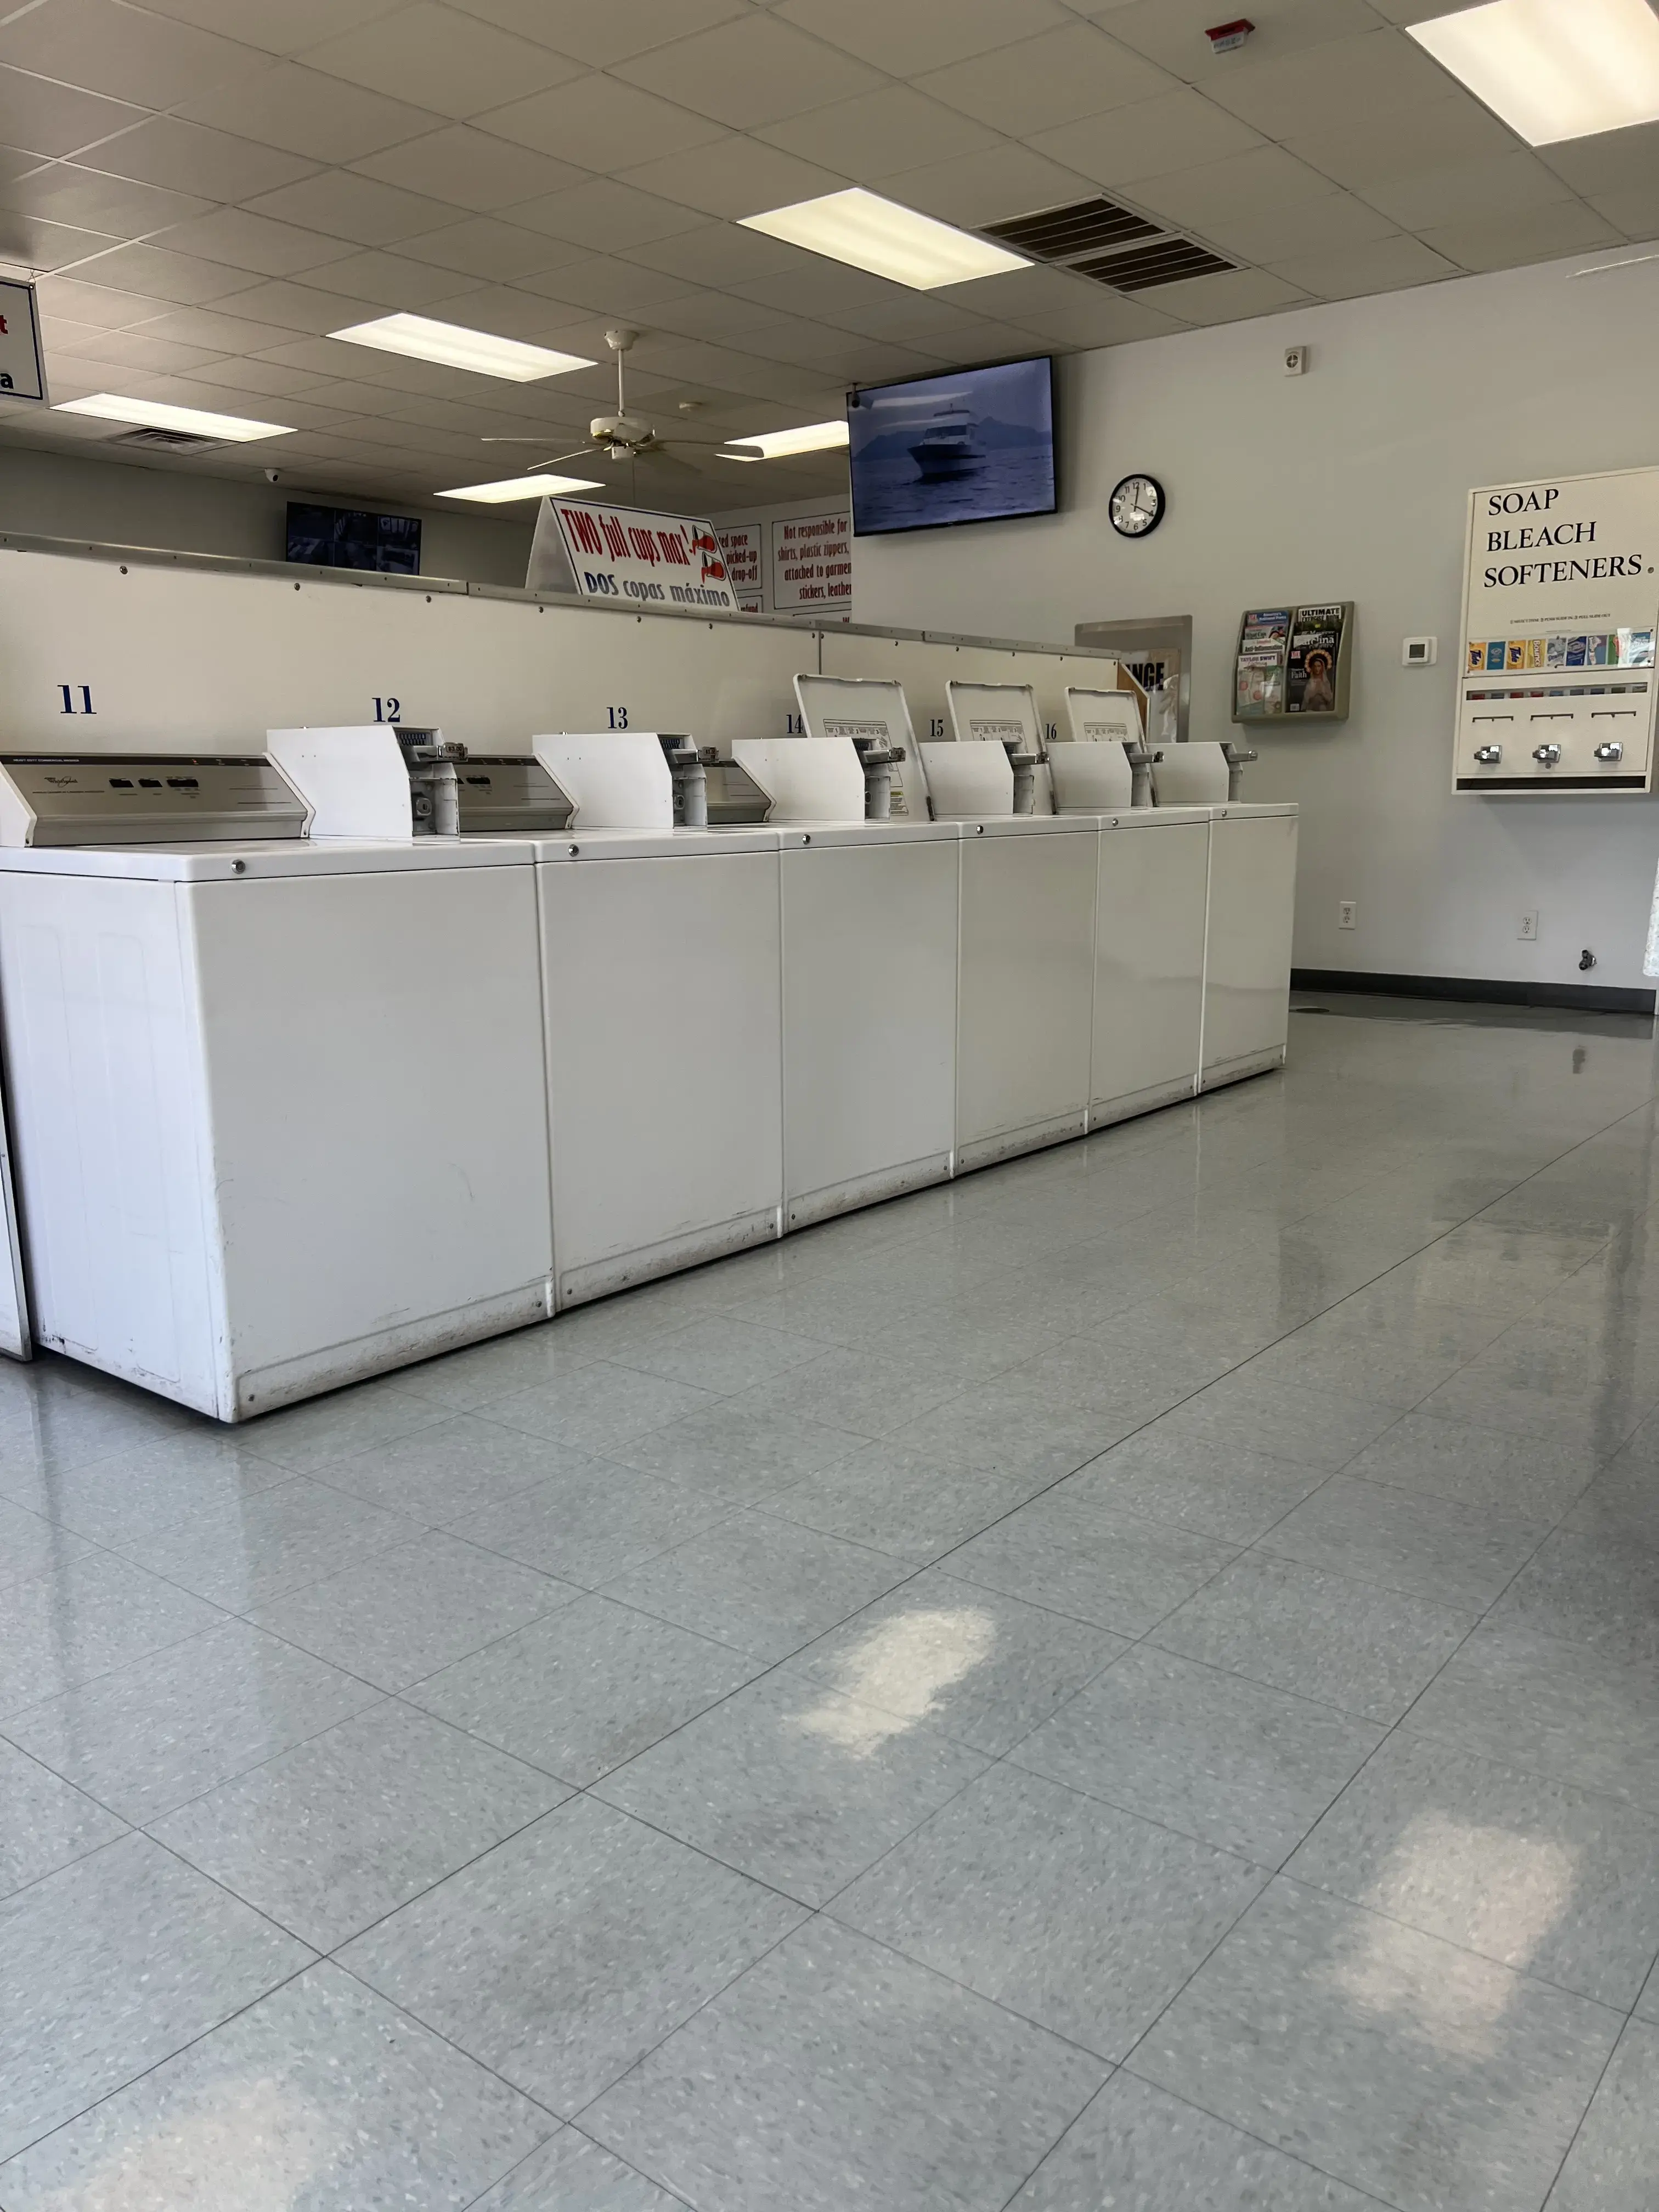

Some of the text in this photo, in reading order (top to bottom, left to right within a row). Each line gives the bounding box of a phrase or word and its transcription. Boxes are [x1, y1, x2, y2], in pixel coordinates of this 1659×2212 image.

[1488, 488, 1559, 516] SOAP
[560, 509, 693, 567] TWO full cups max!
[784, 518, 848, 540] Not responsible for
[1486, 521, 1597, 552] BLEACH
[731, 534, 748, 549] space
[778, 541, 849, 561] shirts, plastic zippers,
[726, 549, 757, 566] picked-up
[732, 565, 758, 582] drop-off
[785, 564, 814, 581] attached
[816, 565, 823, 577] to
[1484, 554, 1642, 588] SOFTENERS
[584, 572, 730, 607] DOS copas máximo
[799, 584, 826, 600] stickers,
[1302, 608, 1340, 616] ULTIMATE
[1533, 640, 1541, 668] Bounce
[1291, 670, 1307, 679] Faith
[57, 685, 97, 714] 11
[372, 697, 400, 723] 12
[606, 707, 628, 729] 13
[786, 714, 803, 734] 14
[930, 719, 944, 737] 15
[1045, 723, 1057, 740] 16
